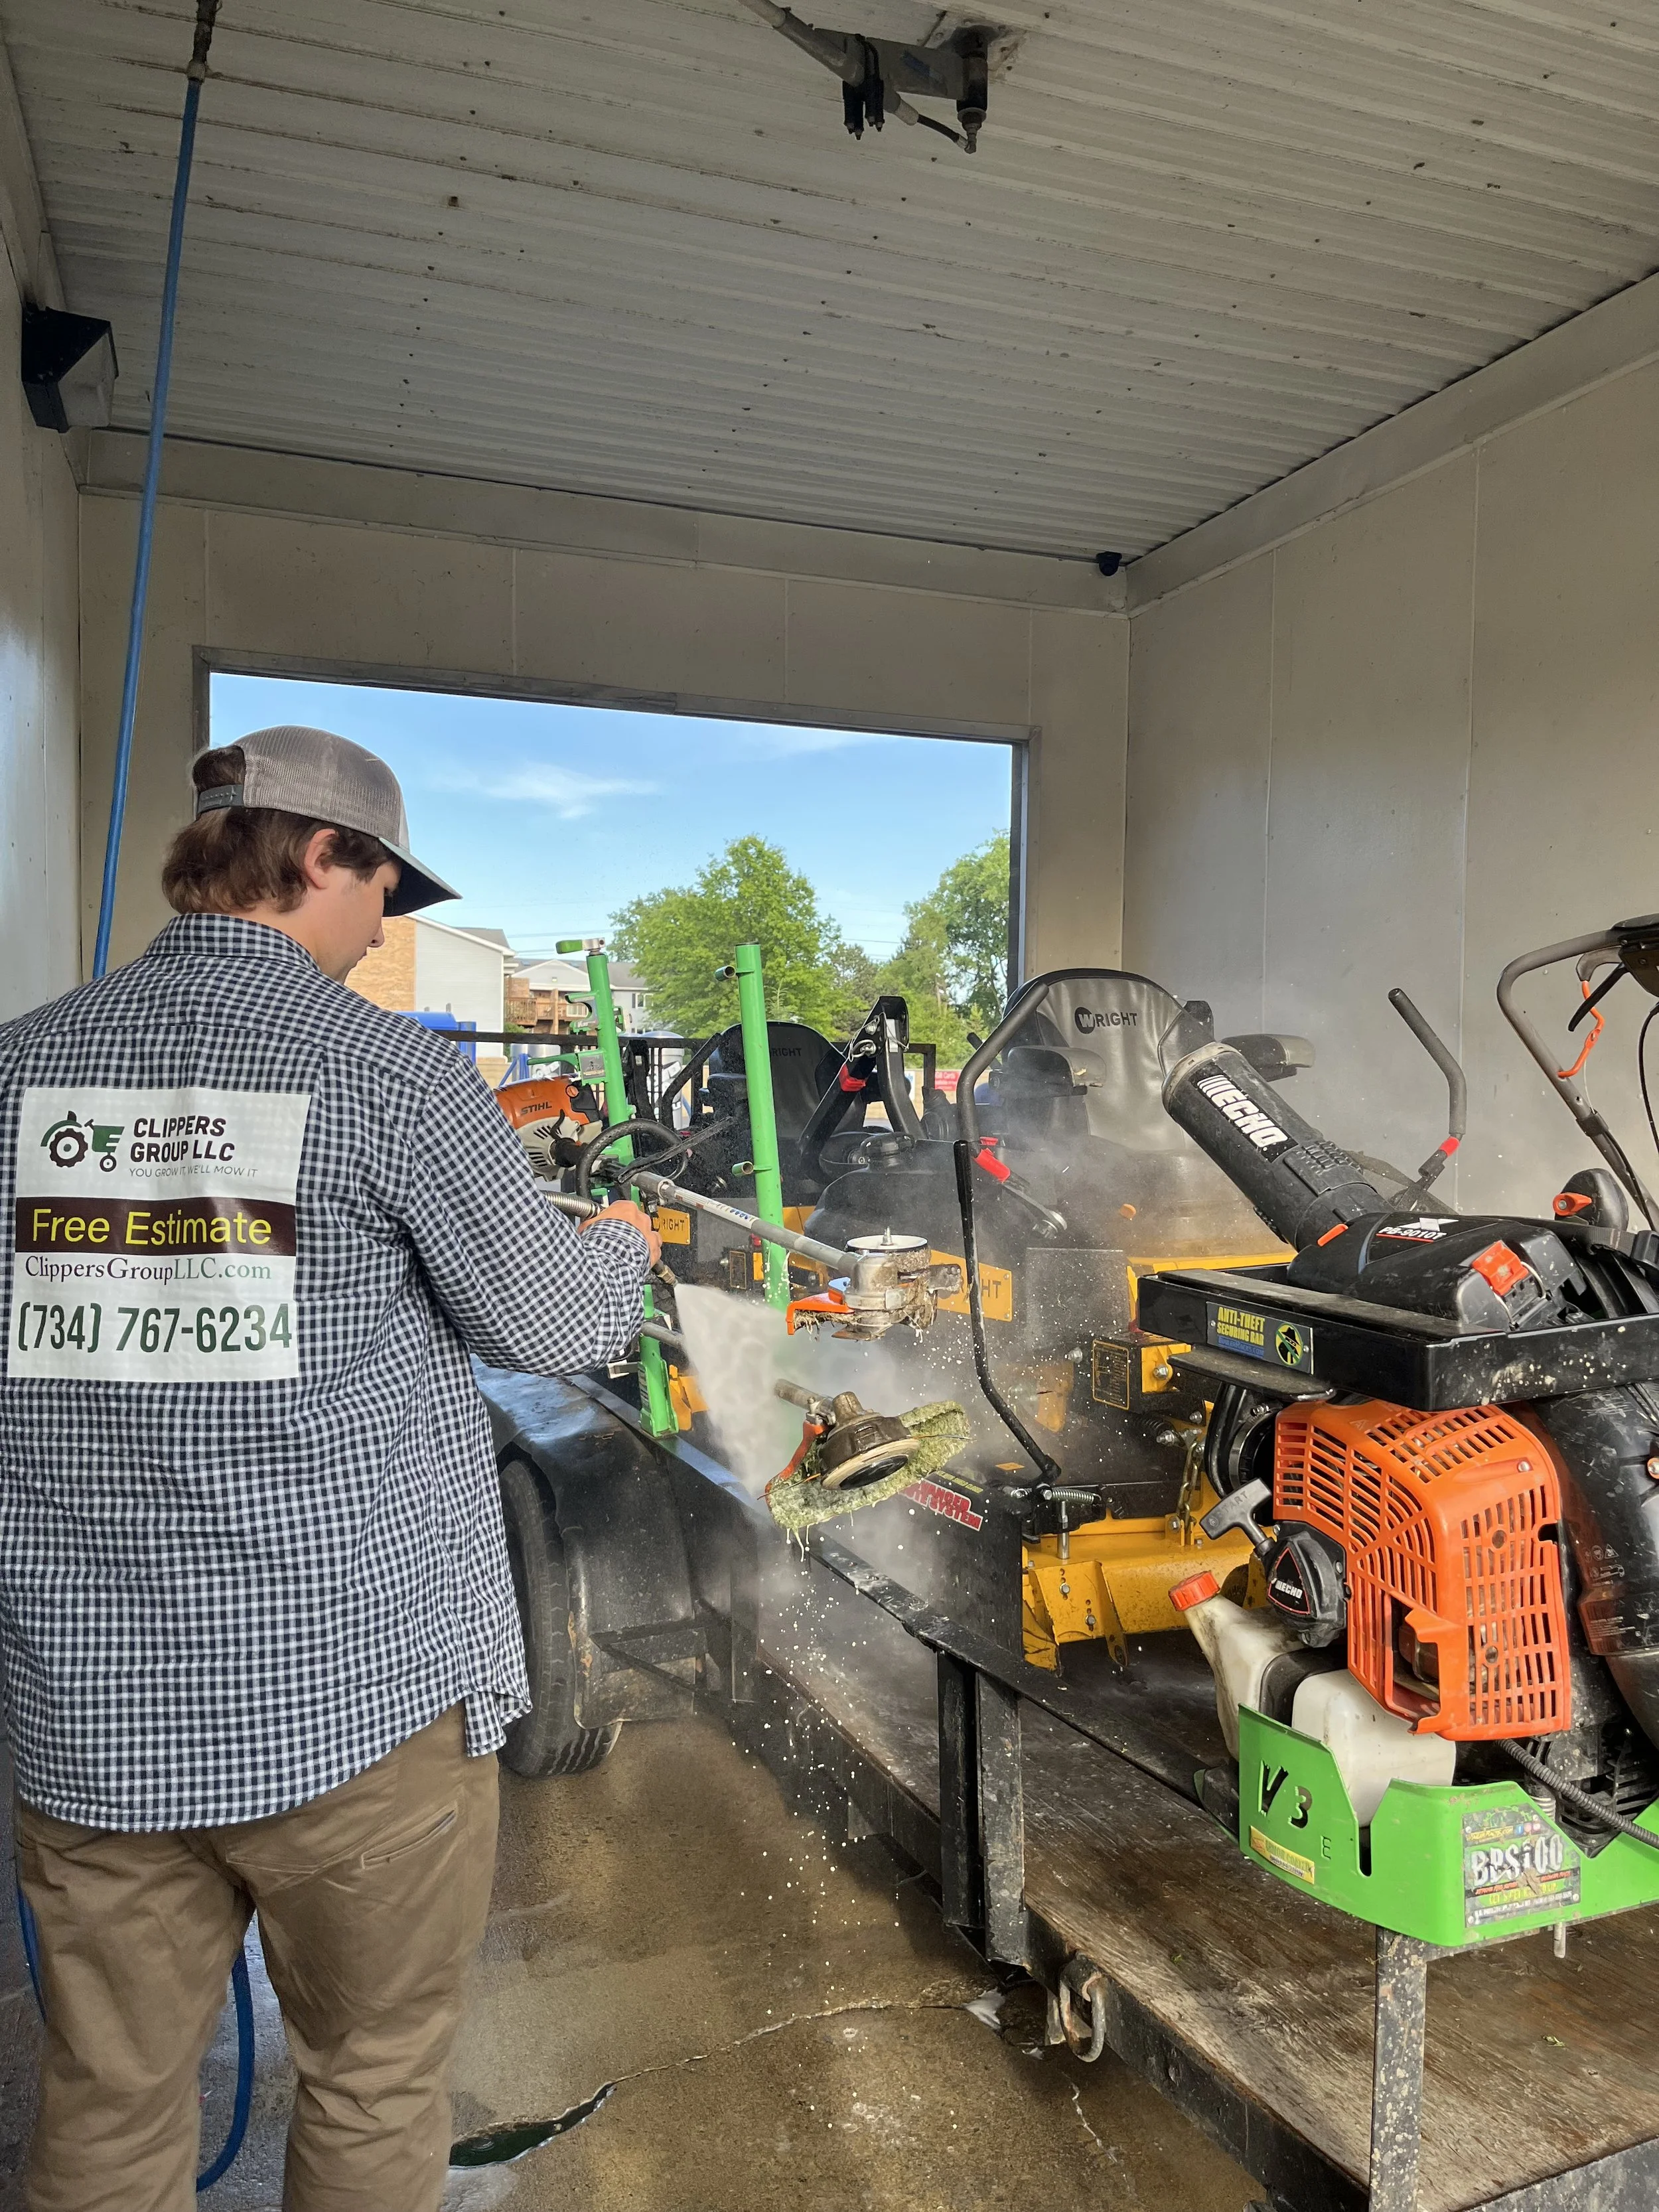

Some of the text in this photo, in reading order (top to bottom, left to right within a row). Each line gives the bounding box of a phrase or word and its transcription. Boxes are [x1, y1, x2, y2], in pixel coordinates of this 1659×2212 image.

[1075, 1008, 1137, 1032] WRIGHT
[771, 1047, 802, 1057] RIGHT
[520, 1102, 552, 1116] STIHL
[1202, 1080, 1288, 1147] ECHO
[133, 1115, 226, 1138] CLIPPERS
[130, 1140, 235, 1163] GROUP LLC
[129, 1168, 152, 1177] YOU
[155, 1167, 178, 1177] GROW
[187, 1165, 210, 1174] WE'LL
[214, 1166, 246, 1176] MOW
[247, 1169, 258, 1177] IT
[33, 1209, 272, 1246] Free Estimate
[1378, 1226, 1447, 1240] PB-9010T
[25, 1255, 272, 1286] ClippersGroupLLC.com
[18, 1301, 293, 1353] (734) 767-6234
[1217, 1306, 1265, 1333] ANTI-THEFT
[1216, 1322, 1264, 1346] SECURING BAR
[920, 1481, 970, 1511] VANCED
[1217, 1491, 1248, 1517] TART
[929, 1495, 981, 1529] SYSTEM
[1277, 1582, 1303, 1599] ECHO
